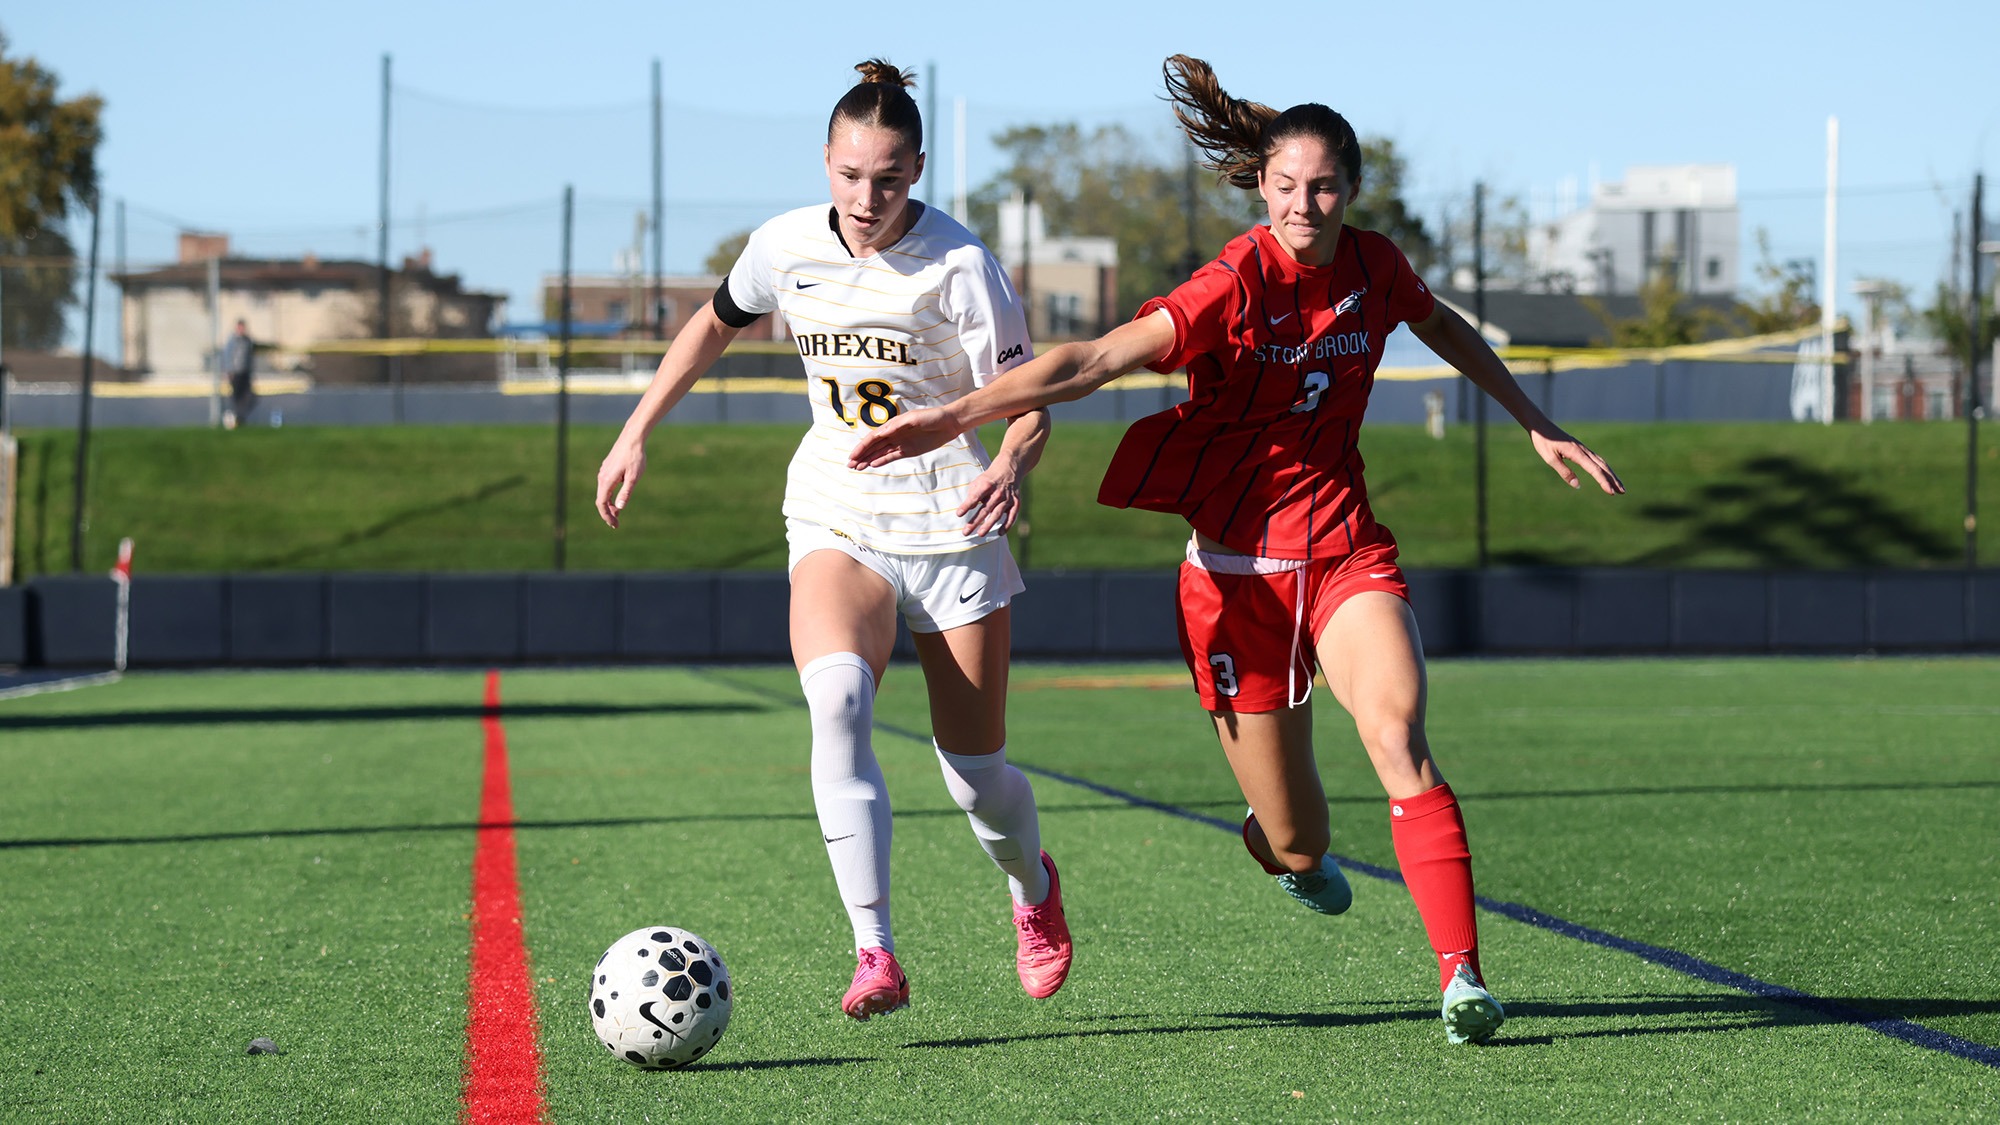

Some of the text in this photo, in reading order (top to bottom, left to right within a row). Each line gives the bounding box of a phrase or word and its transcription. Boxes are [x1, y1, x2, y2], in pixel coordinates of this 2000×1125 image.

[797, 333, 917, 365] DREXEL
[997, 344, 1023, 364] CAA
[1316, 332, 1370, 359] BROOK
[820, 376, 900, 429] 18
[1290, 371, 1329, 413] 3
[1208, 652, 1239, 697] 3
